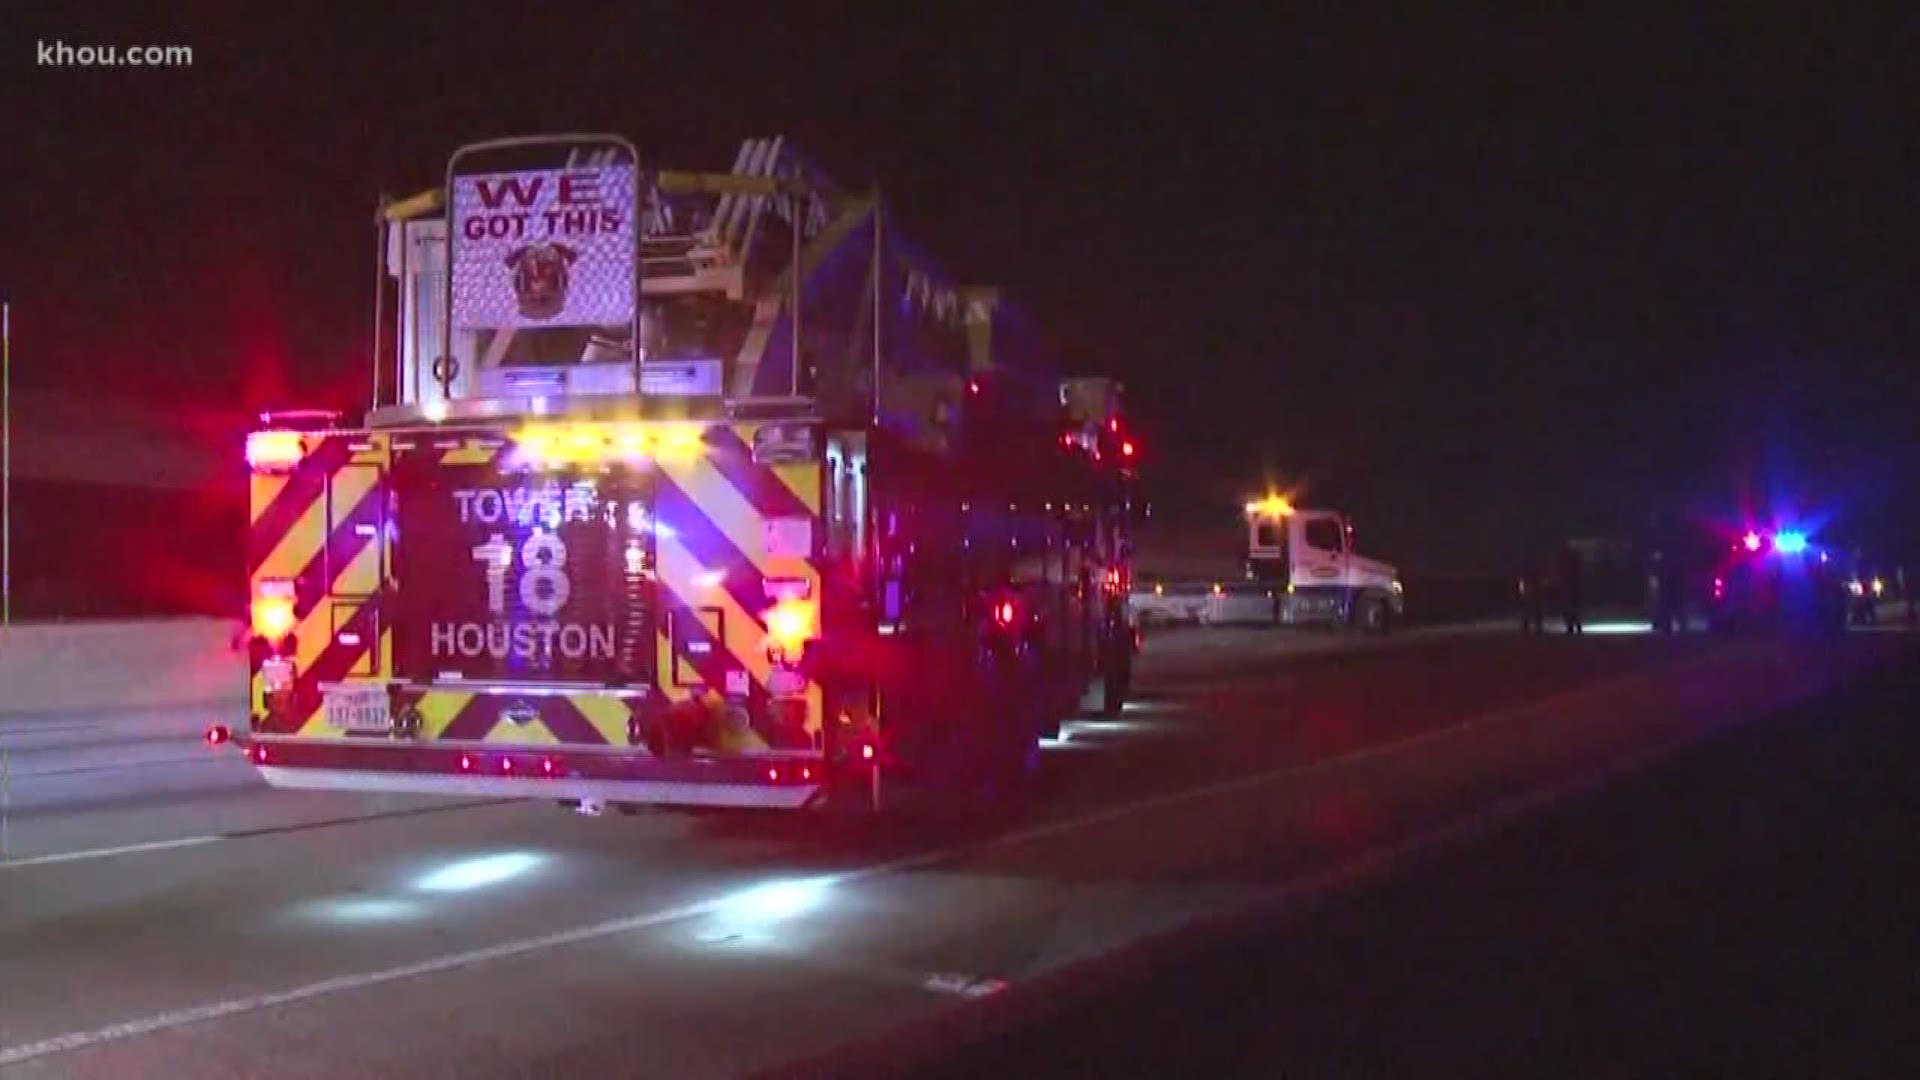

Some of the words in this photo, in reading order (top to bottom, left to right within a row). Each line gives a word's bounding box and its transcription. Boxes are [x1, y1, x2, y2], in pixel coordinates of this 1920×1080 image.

[476, 174, 600, 209] WE
[465, 214, 530, 239] GOT
[543, 208, 621, 235] THIS
[453, 484, 596, 525] TOWER
[472, 532, 570, 616] 18
[431, 621, 615, 659] HOUSTON
